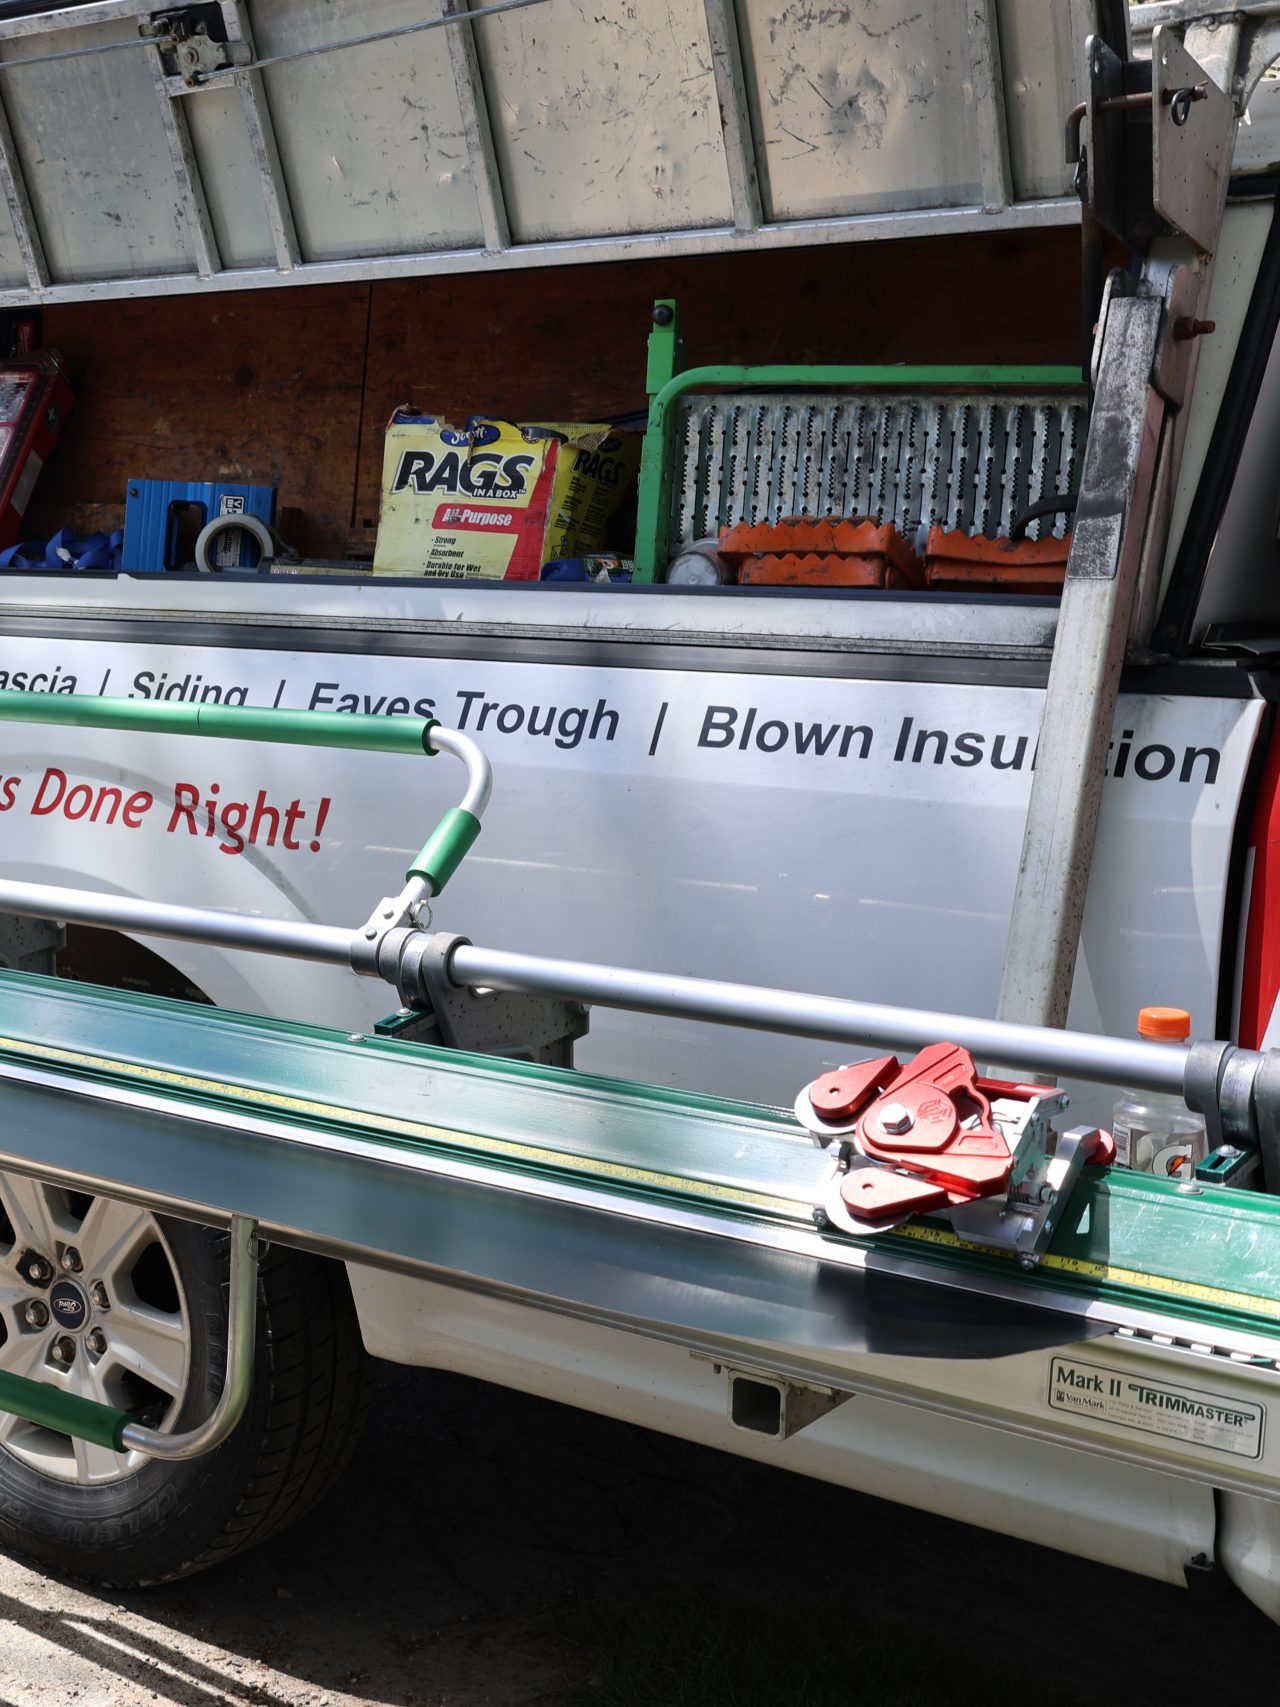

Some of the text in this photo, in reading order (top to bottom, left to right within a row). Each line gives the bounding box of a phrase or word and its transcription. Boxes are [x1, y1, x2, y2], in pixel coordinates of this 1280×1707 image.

[393, 451, 536, 492] RAGS
[572, 449, 626, 484] RAGS
[473, 488, 485, 497] IN
[486, 489, 494, 497] A
[442, 508, 513, 526] All-Purpose
[430, 548, 464, 558] Absorbent
[434, 536, 457, 545] Strong
[426, 561, 482, 572] Durable for Wet
[128, 671, 249, 707] Siding
[307, 682, 436, 719] Eaves
[455, 690, 620, 750] Trough
[697, 705, 874, 760] Blown
[30, 766, 154, 831] Done
[166, 782, 332, 855] Right!
[1057, 1366, 1103, 1394] Mark
[1109, 1378, 1122, 1398] II
